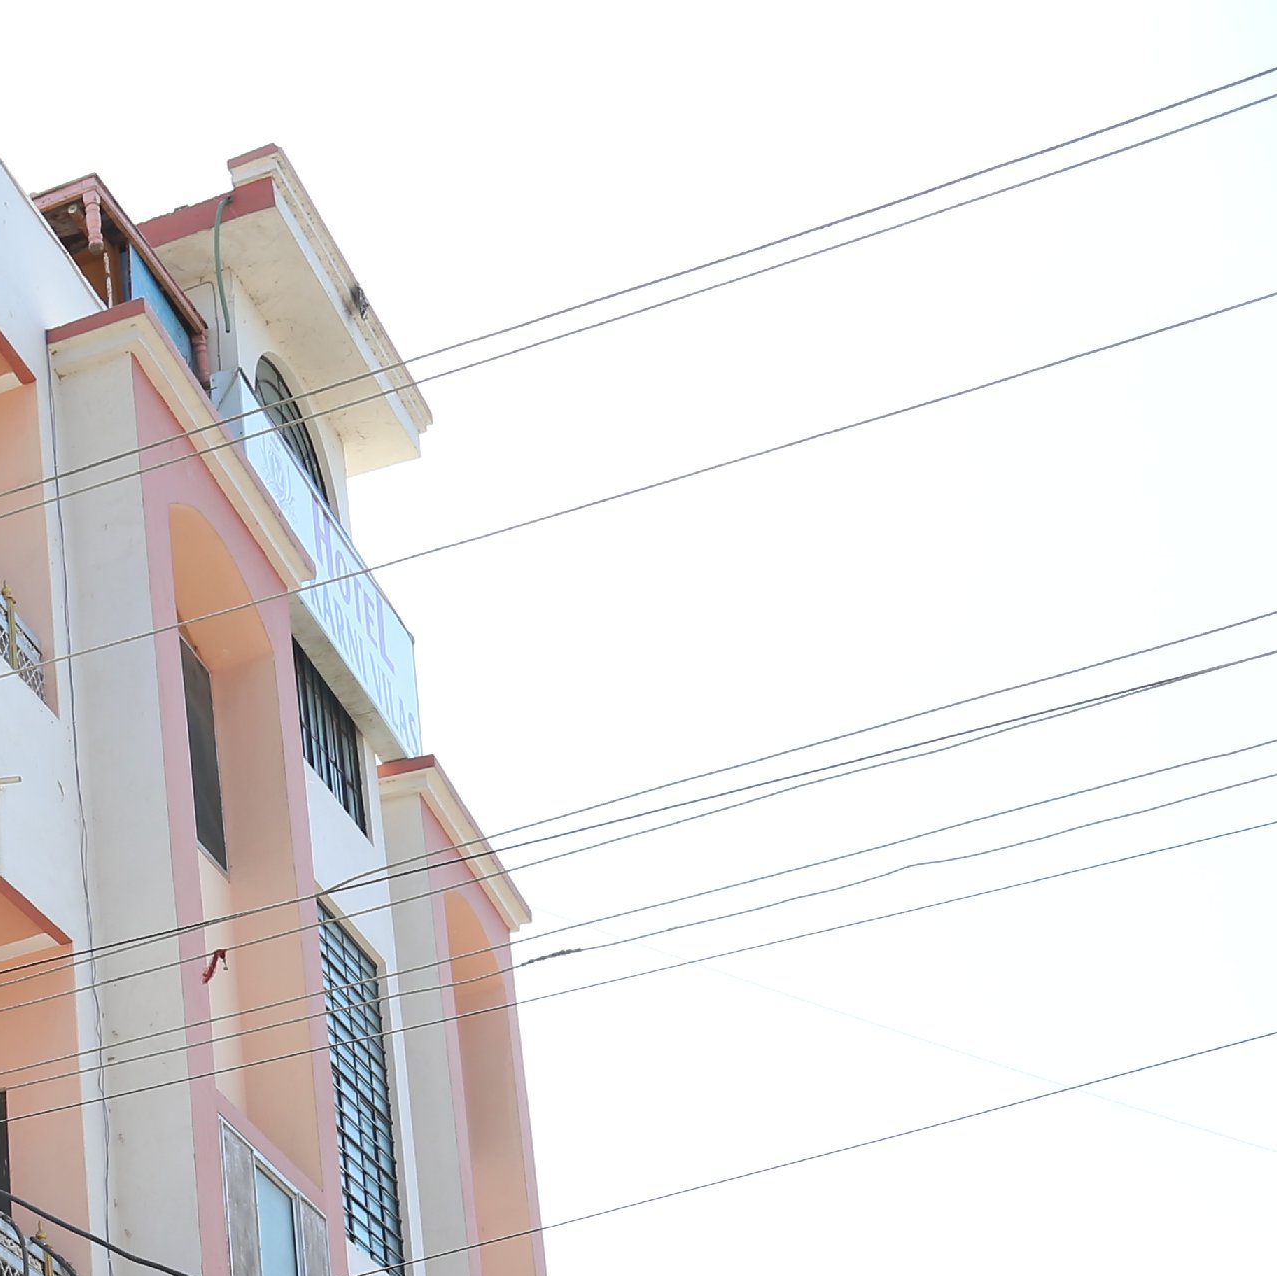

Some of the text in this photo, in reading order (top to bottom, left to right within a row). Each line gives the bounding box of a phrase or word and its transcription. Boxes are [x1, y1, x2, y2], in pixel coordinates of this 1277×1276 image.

[310, 578, 419, 757] KARNI VILAS
[312, 494, 395, 674] HOTEL
